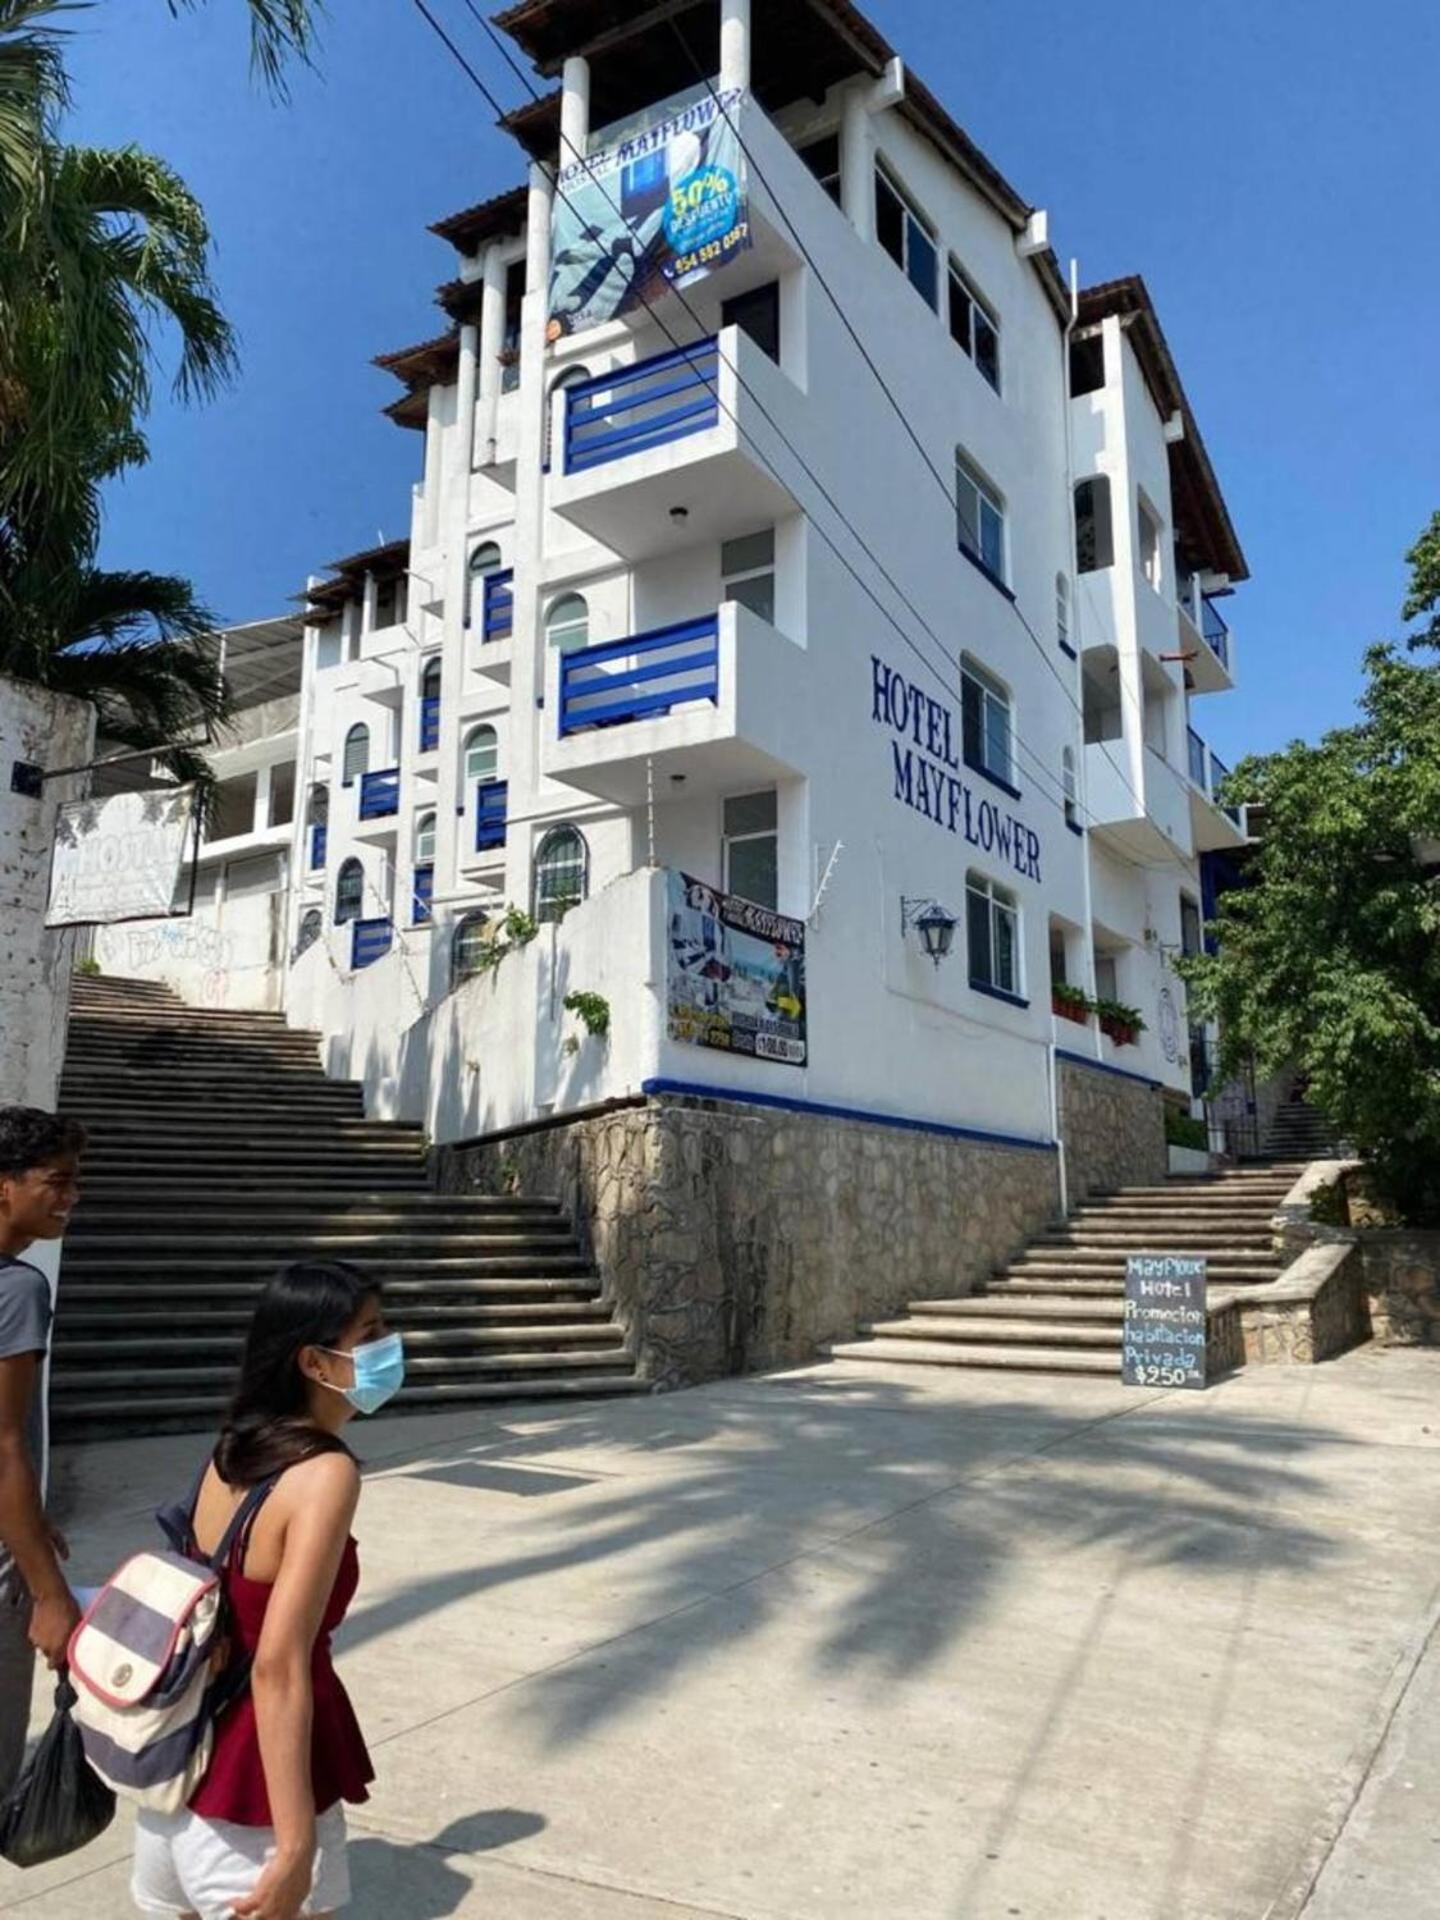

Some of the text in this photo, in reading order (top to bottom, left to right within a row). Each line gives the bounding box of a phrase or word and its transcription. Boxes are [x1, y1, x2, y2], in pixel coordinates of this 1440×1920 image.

[671, 169, 729, 218] 50%
[871, 653, 959, 770] HOTEL
[892, 740, 1042, 884] MAYFLOWER
[1124, 1345, 1196, 1368] Privada
